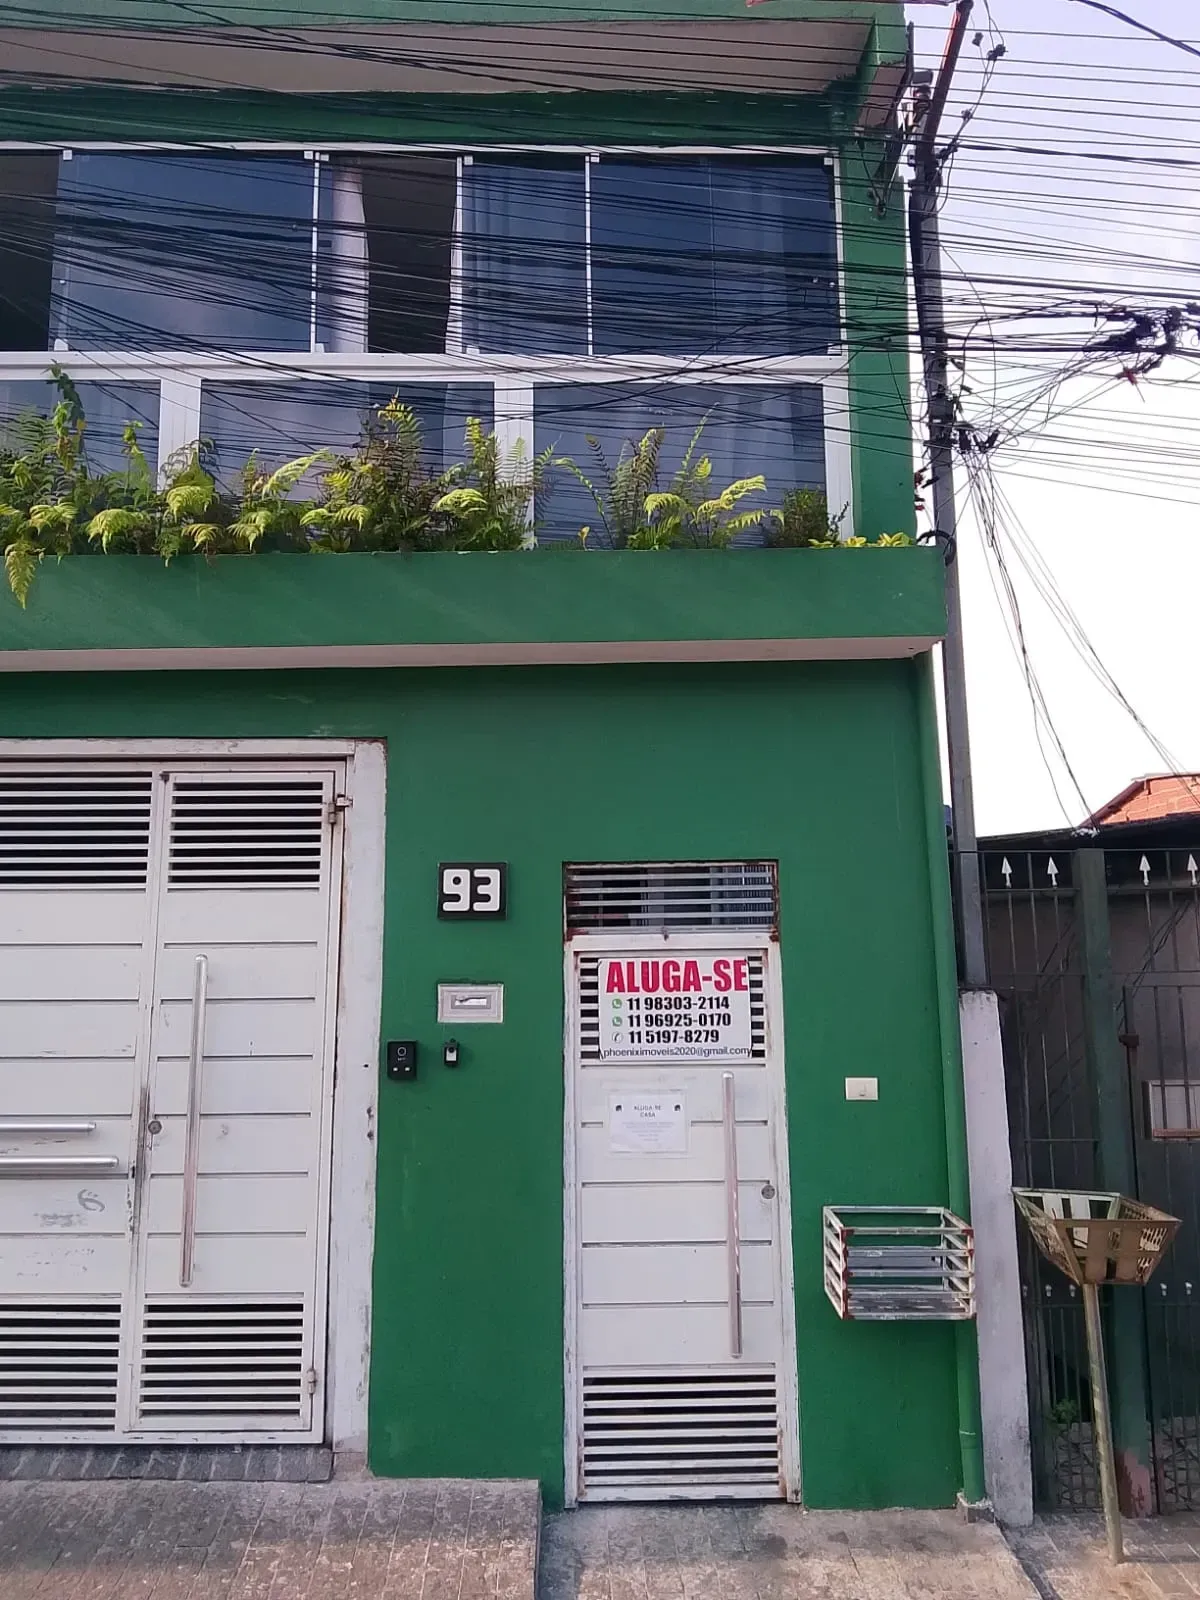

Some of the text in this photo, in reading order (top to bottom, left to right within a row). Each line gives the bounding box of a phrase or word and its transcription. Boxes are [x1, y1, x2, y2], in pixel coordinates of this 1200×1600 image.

[443, 869, 500, 911] 93
[606, 960, 748, 993] ALUGA-SE
[626, 996, 730, 1010] 11 98303-2114
[627, 1013, 731, 1027] 11 96925-0170
[629, 1029, 719, 1044] 11 5197-8279
